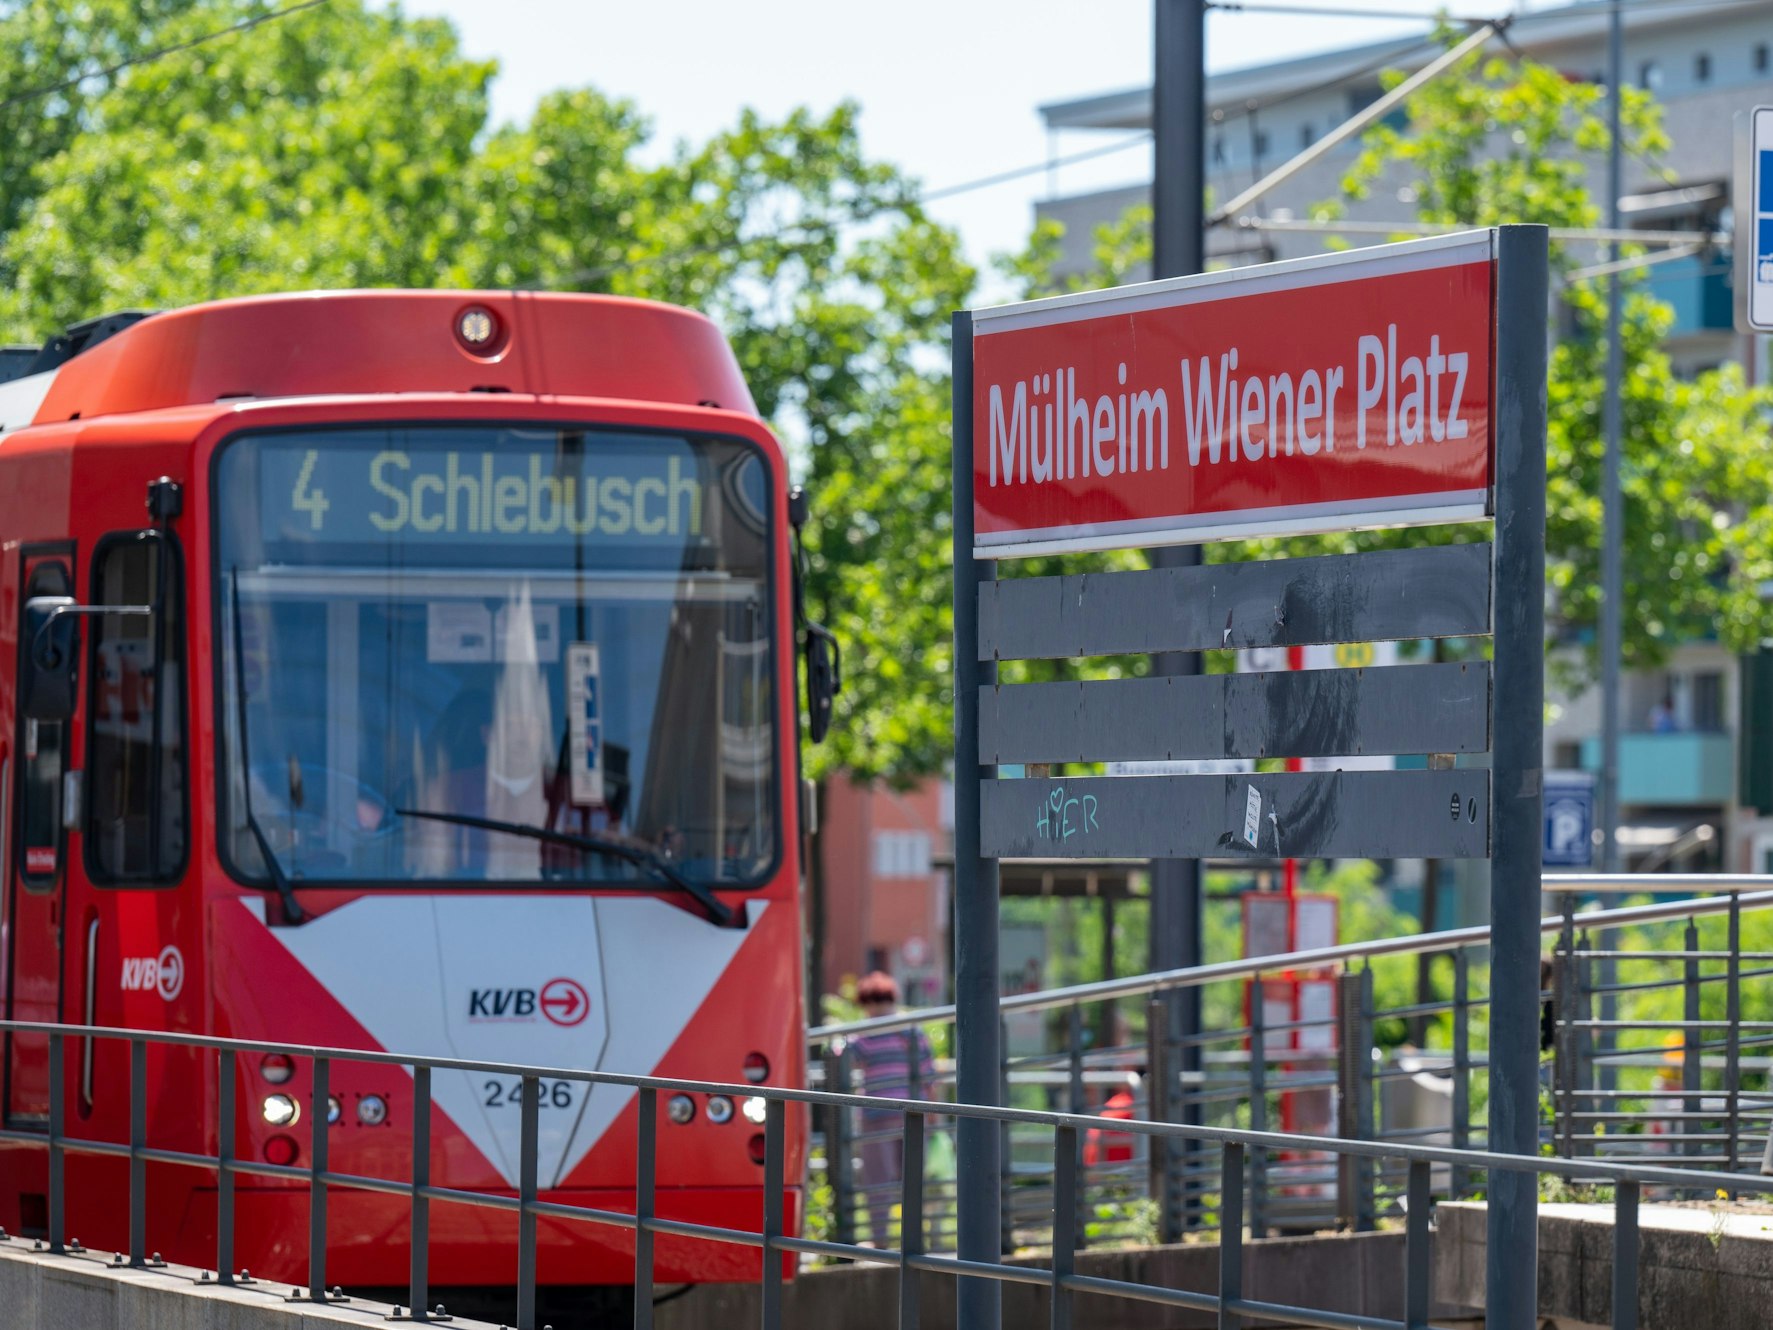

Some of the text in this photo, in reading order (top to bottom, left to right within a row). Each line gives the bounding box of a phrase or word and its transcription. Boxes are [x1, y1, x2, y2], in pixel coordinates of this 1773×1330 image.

[988, 323, 1470, 488] Mülheim Wiener Platz
[291, 448, 702, 536] 4 Schlebusch
[120, 957, 157, 991] KVB
[468, 988, 536, 1017] KVB
